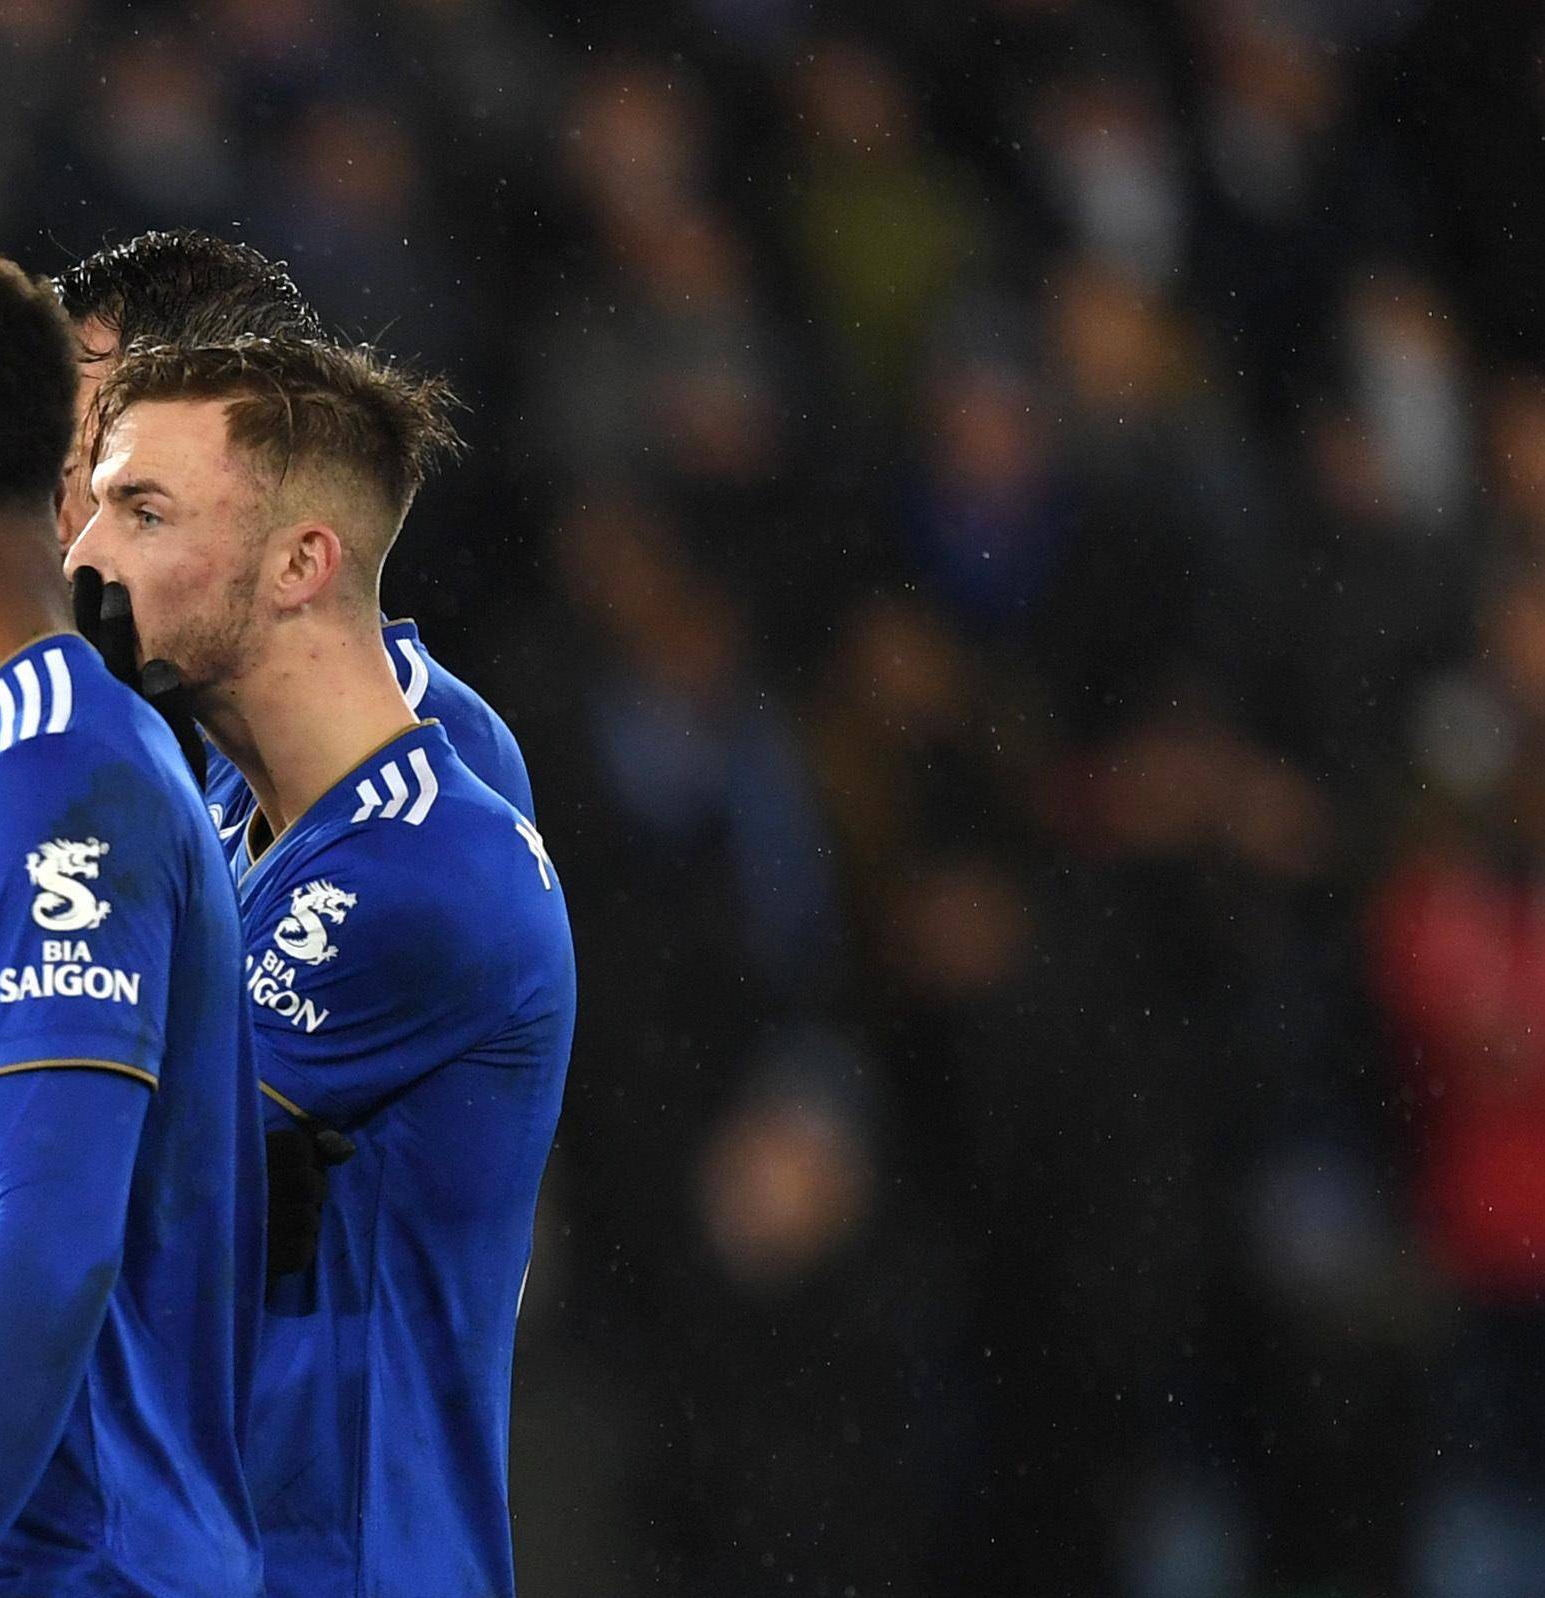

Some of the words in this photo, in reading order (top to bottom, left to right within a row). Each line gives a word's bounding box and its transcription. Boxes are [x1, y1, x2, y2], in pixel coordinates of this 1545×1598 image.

[42, 940, 92, 962] BIA
[262, 949, 296, 989] BIA
[245, 954, 330, 1034] IGON
